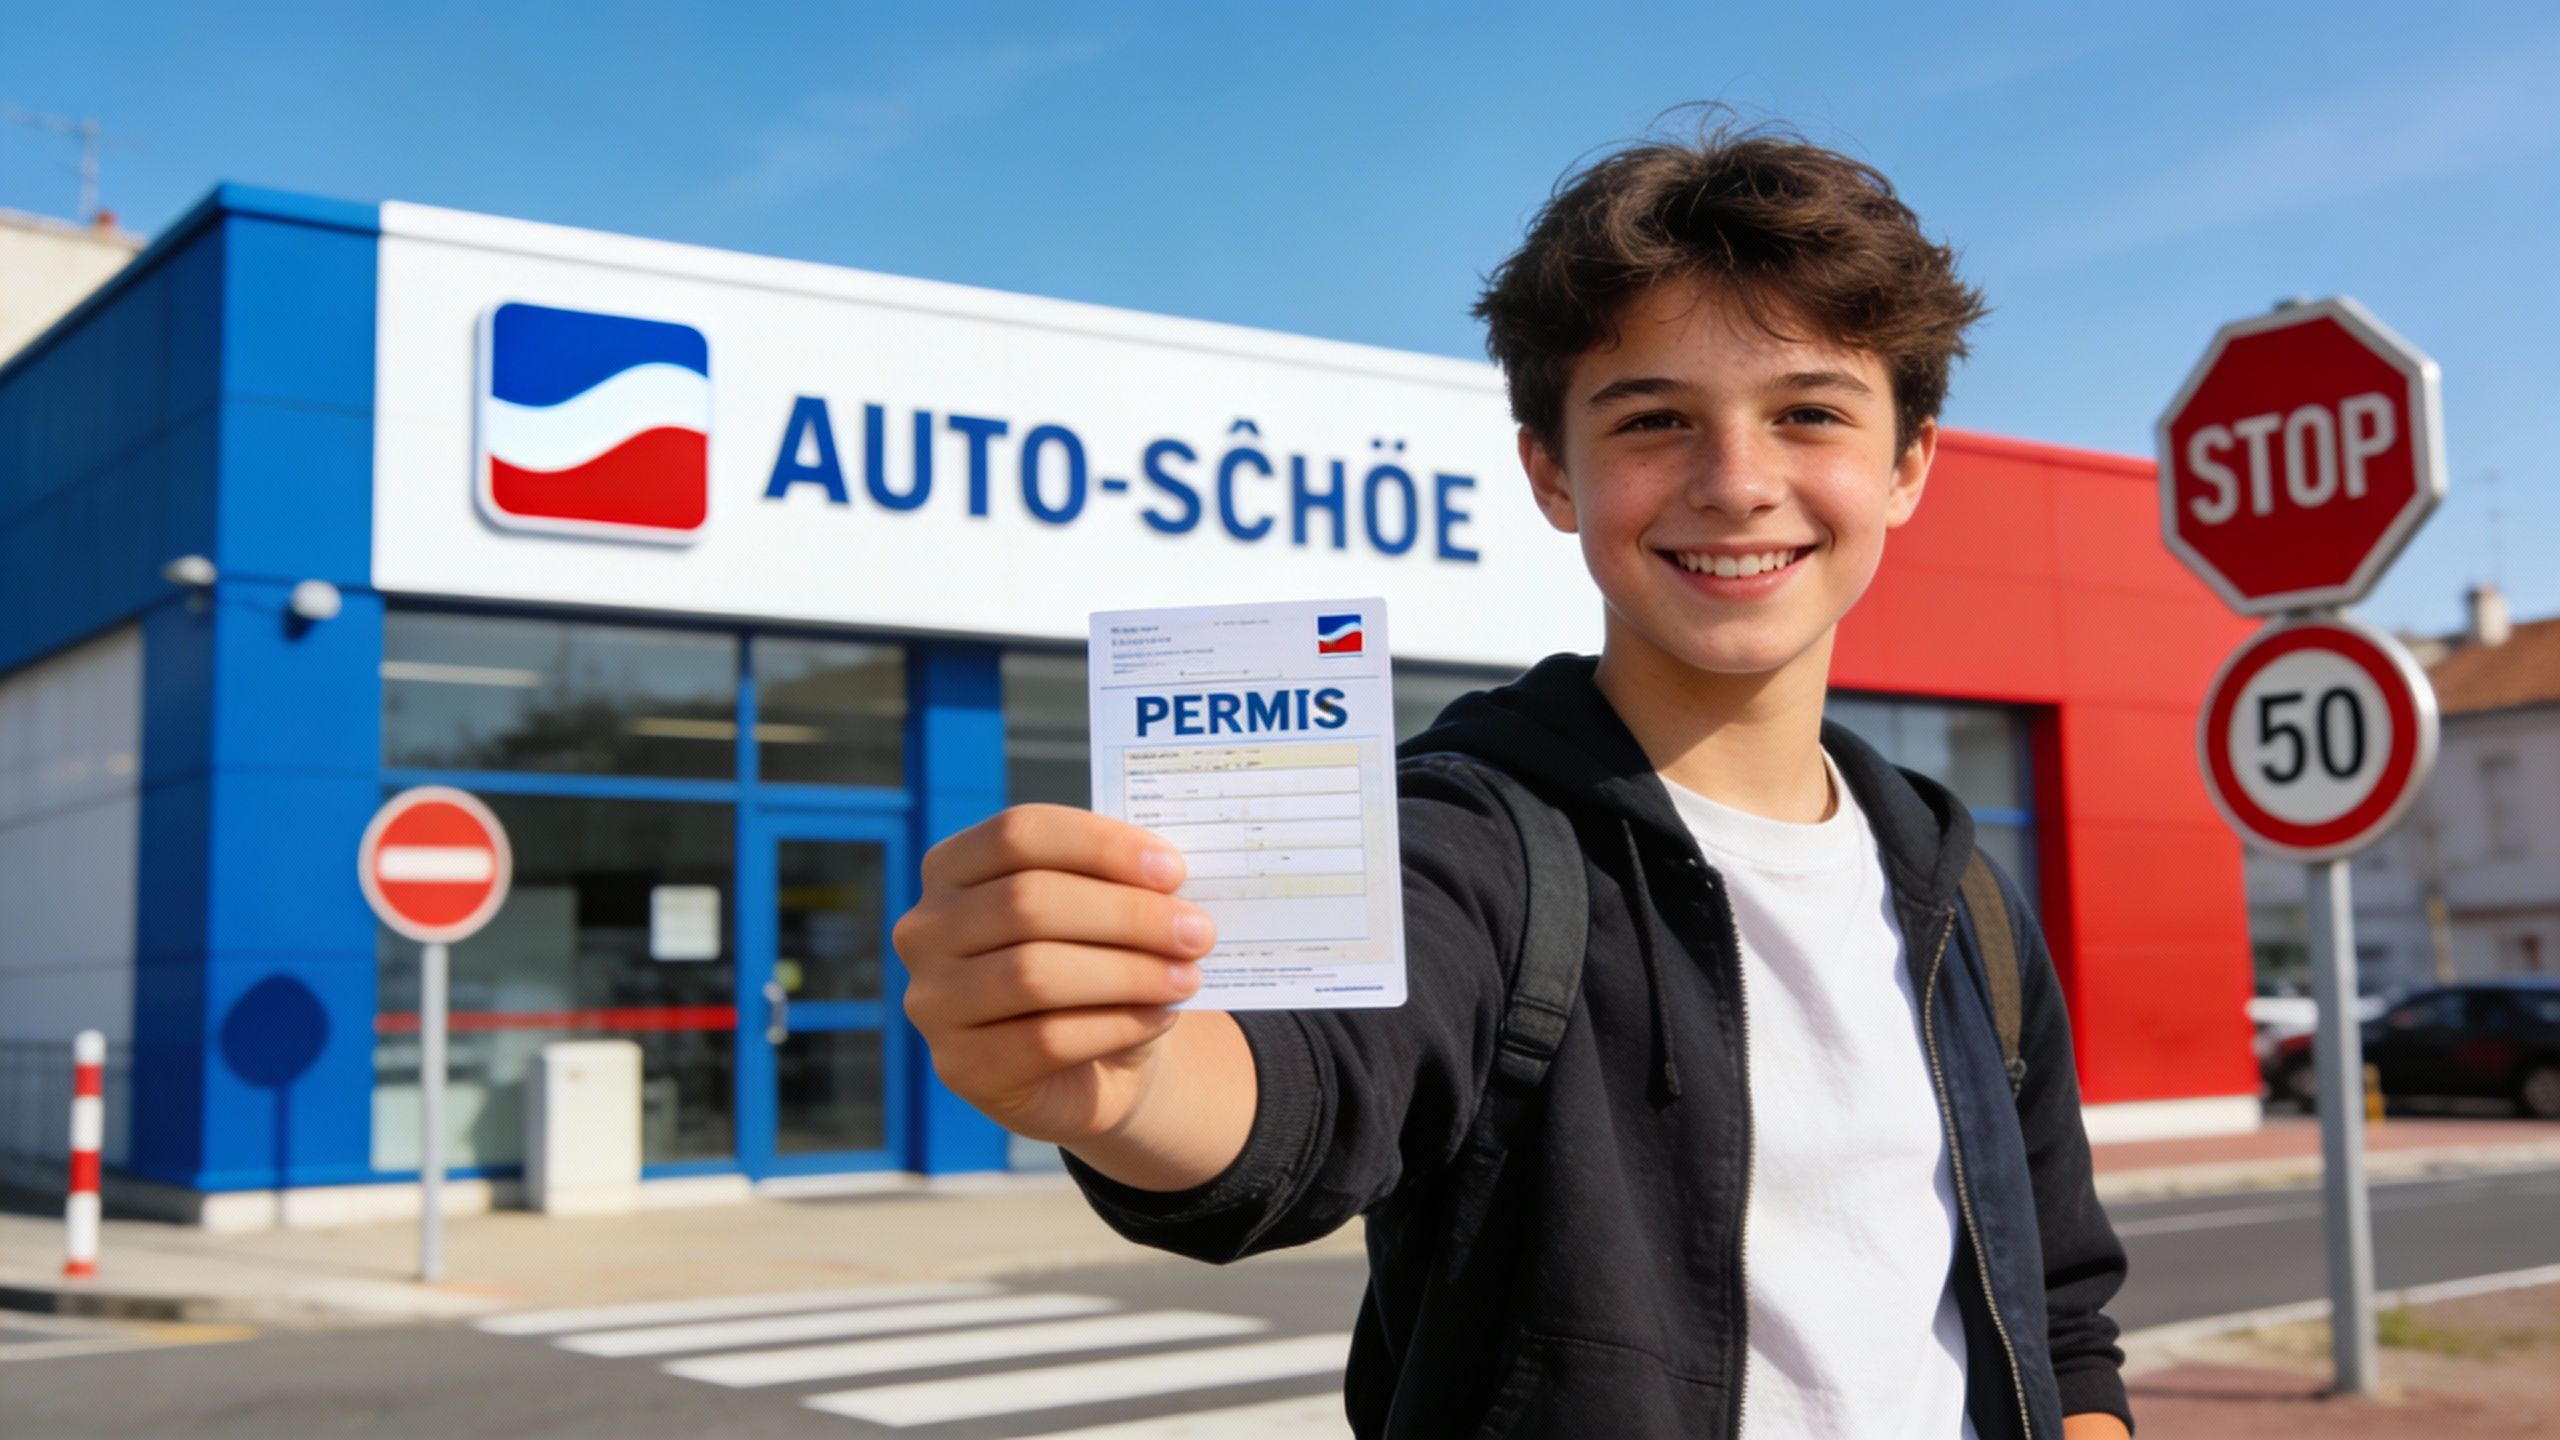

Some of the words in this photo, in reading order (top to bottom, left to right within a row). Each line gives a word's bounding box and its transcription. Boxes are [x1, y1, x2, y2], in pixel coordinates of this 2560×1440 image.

[763, 395, 1481, 563] AUTO-SĈHÖE
[2186, 391, 2397, 525] STOP
[1136, 687, 1348, 737] PERMIS
[2256, 685, 2366, 786] 50
